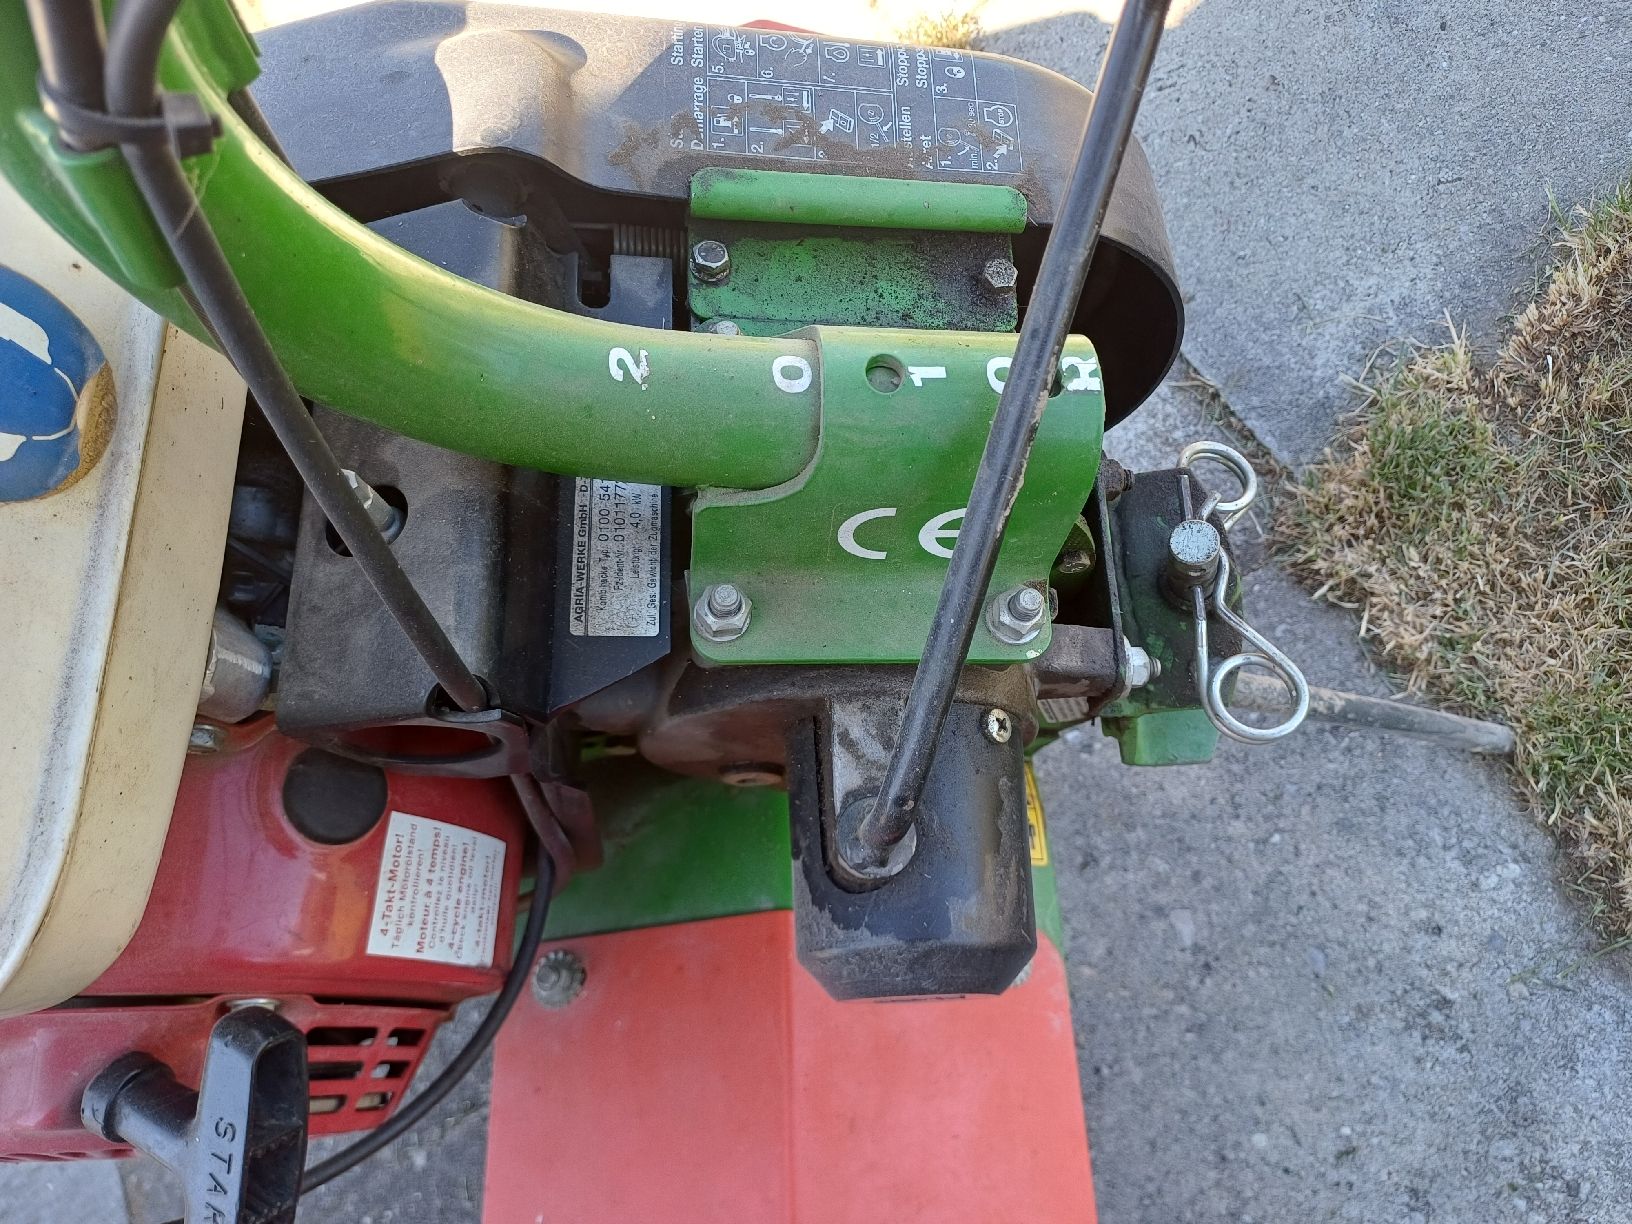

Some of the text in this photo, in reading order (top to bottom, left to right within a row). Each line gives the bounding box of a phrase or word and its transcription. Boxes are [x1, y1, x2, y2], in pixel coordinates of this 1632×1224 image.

[712, 62, 724, 73] 5.
[761, 67, 774, 78] 6.
[936, 83, 947, 93] 3.
[712, 138, 724, 149] 1.
[751, 142, 763, 153] 2.
[940, 156, 952, 166] 1.
[986, 159, 998, 170] 2.
[608, 347, 650, 391] 2
[771, 355, 813, 393] 0
[907, 366, 947, 387] 1
[578, 504, 588, 537] GmbH
[837, 507, 967, 560] CE
[574, 540, 587, 623] AGRIA-WERKE
[380, 833, 404, 936] 4-Takt-Motor!
[392, 823, 417, 949] Täglich Motorölstand
[407, 848, 424, 926] kontrollieren!
[416, 827, 441, 953] Moteur à 4 temps!
[448, 842, 469, 950] 4-cycle engine!
